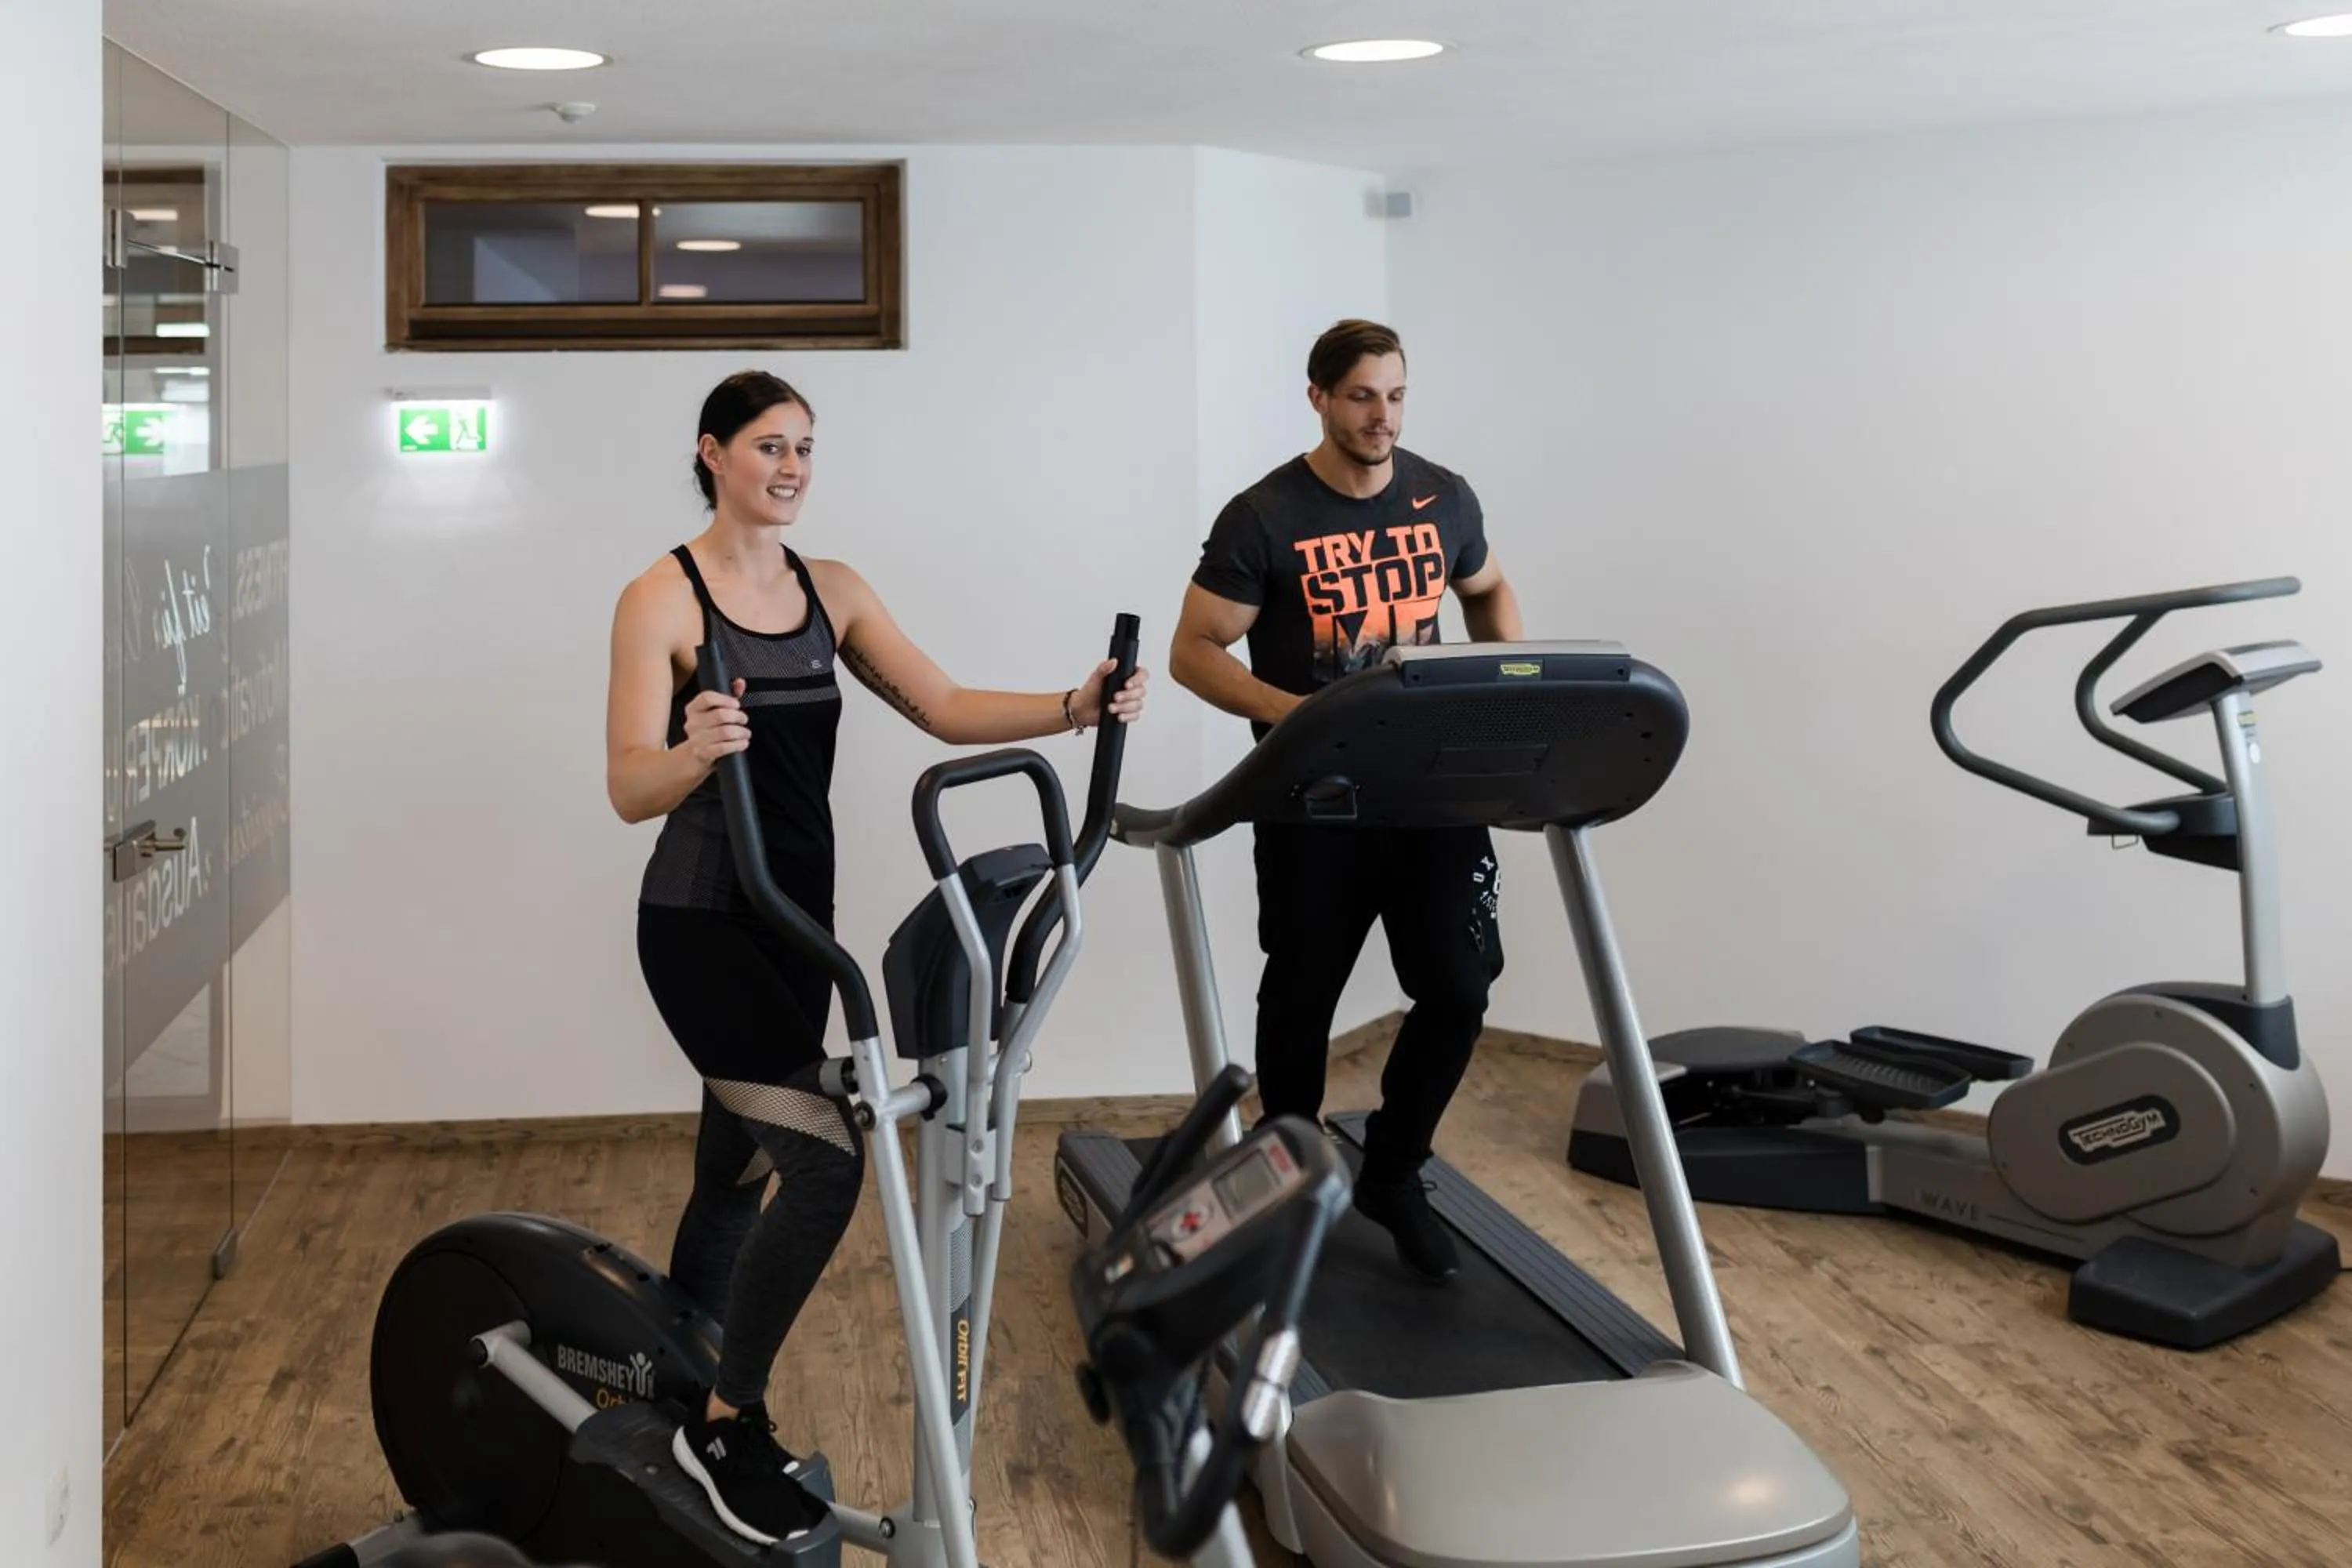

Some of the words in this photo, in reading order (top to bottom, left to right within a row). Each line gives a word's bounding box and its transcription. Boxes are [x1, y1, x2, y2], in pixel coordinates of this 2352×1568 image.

[1294, 529, 1375, 574] TRY
[1386, 523, 1441, 555] TO
[1306, 551, 1443, 615] STOP
[1920, 1189, 1980, 1221] WAVE
[557, 1344, 635, 1393] BREMSHEY
